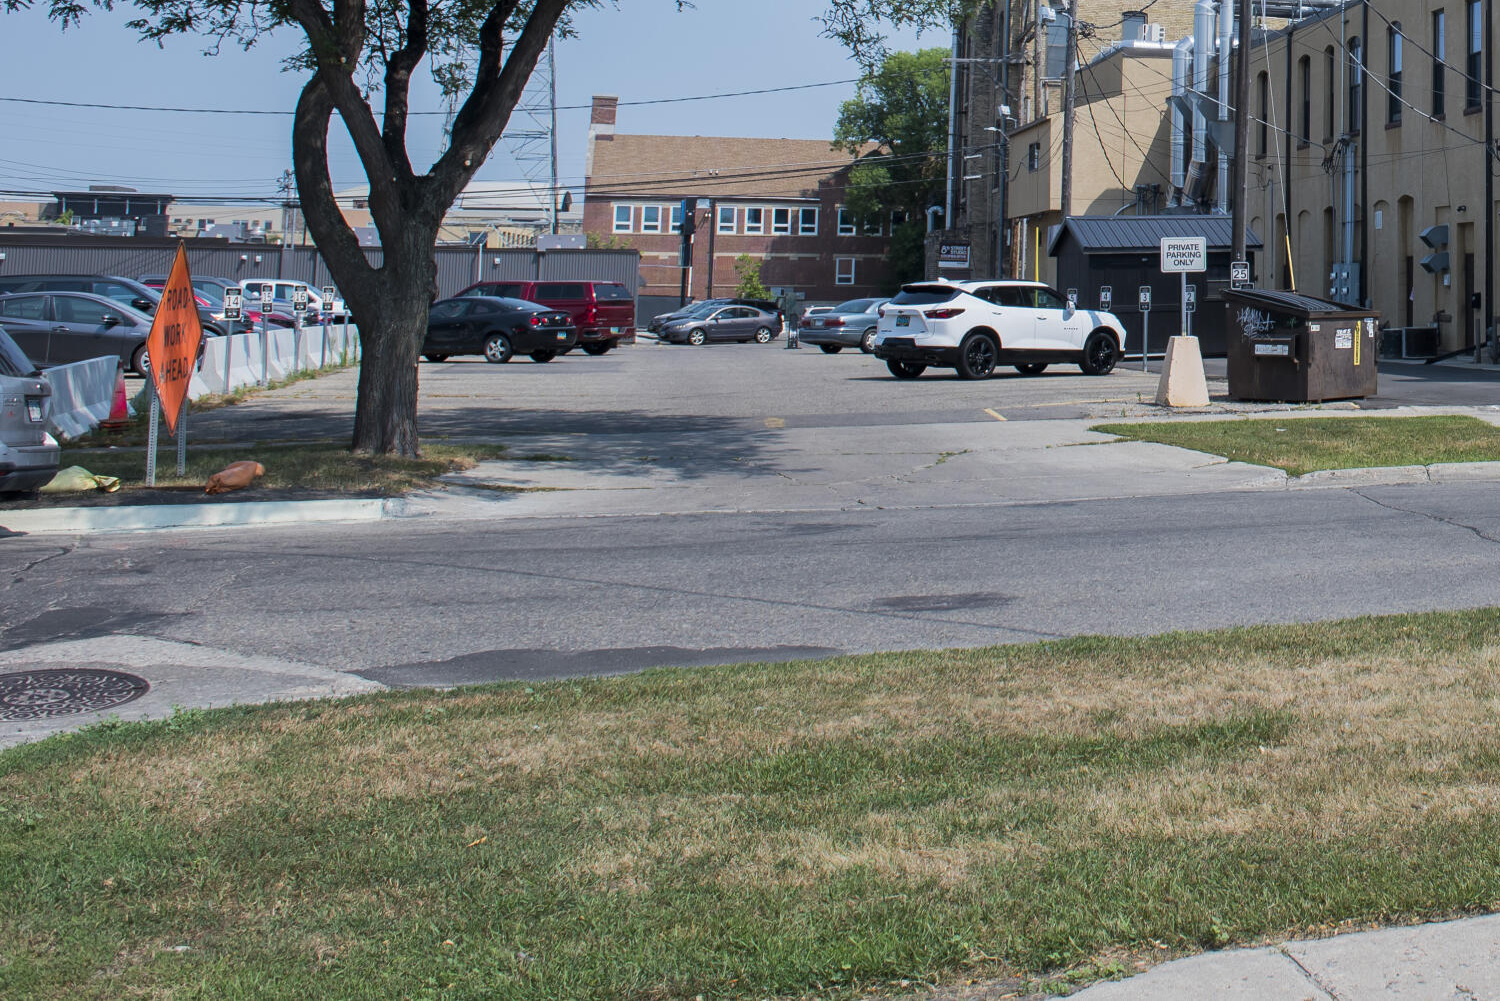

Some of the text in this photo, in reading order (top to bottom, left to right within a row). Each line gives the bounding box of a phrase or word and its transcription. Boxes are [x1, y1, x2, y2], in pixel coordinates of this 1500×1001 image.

[1166, 251, 1201, 259] PARKING
[1233, 269, 1247, 279] 25
[167, 287, 188, 311] ROAD
[227, 296, 239, 307] 14
[263, 292, 272, 302] 15
[295, 292, 306, 301] 16
[323, 293, 333, 302] 17
[1186, 293, 1192, 301] 2
[164, 324, 187, 348] WORK
[159, 356, 188, 383] AHEAD
